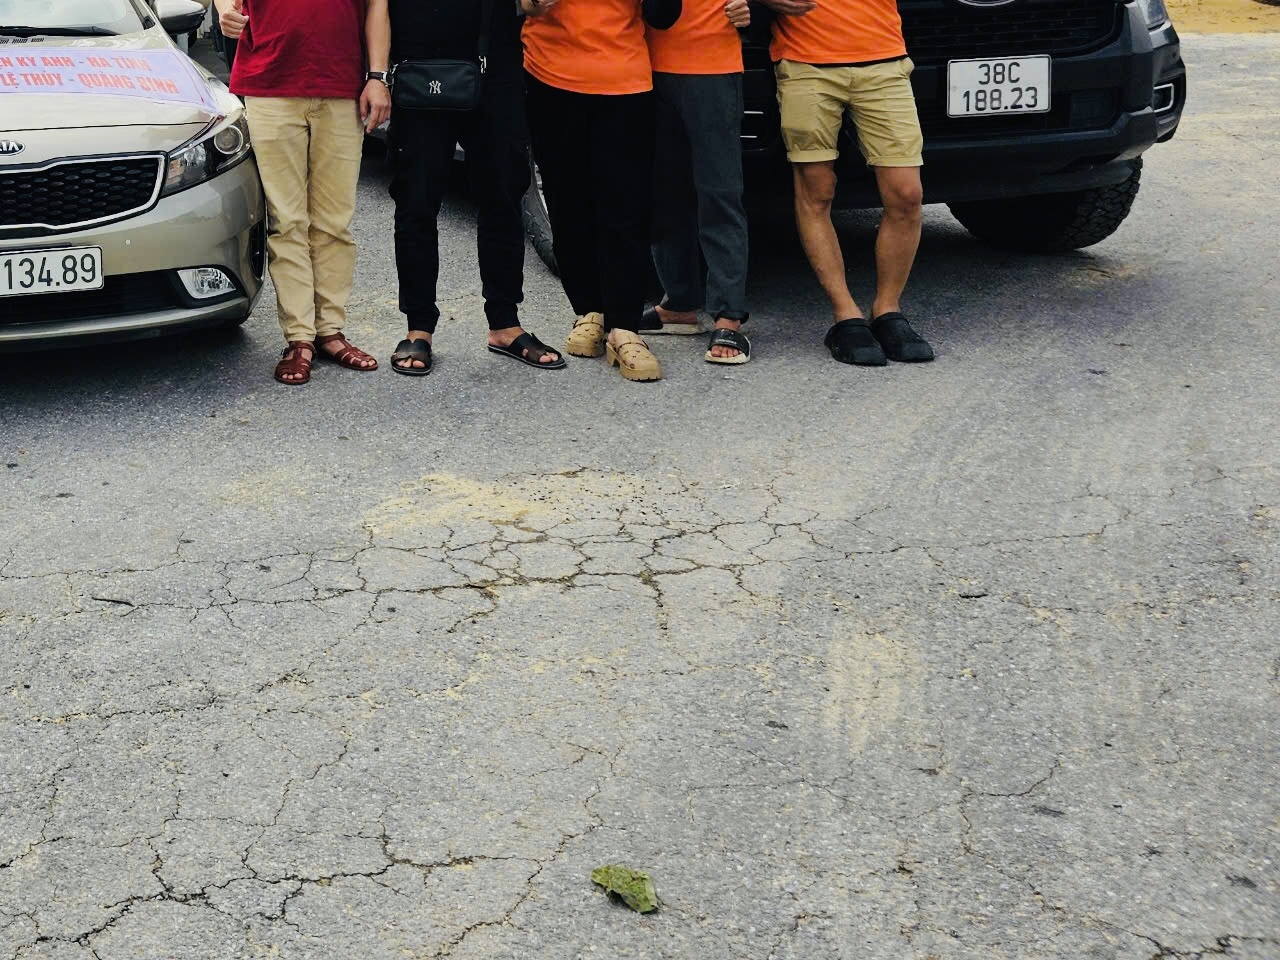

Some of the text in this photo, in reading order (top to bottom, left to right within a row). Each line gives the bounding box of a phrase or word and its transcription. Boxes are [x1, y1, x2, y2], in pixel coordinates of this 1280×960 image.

[40, 56, 75, 67] ANH
[978, 61, 1020, 85] 38C
[963, 86, 1038, 112] 188.23
